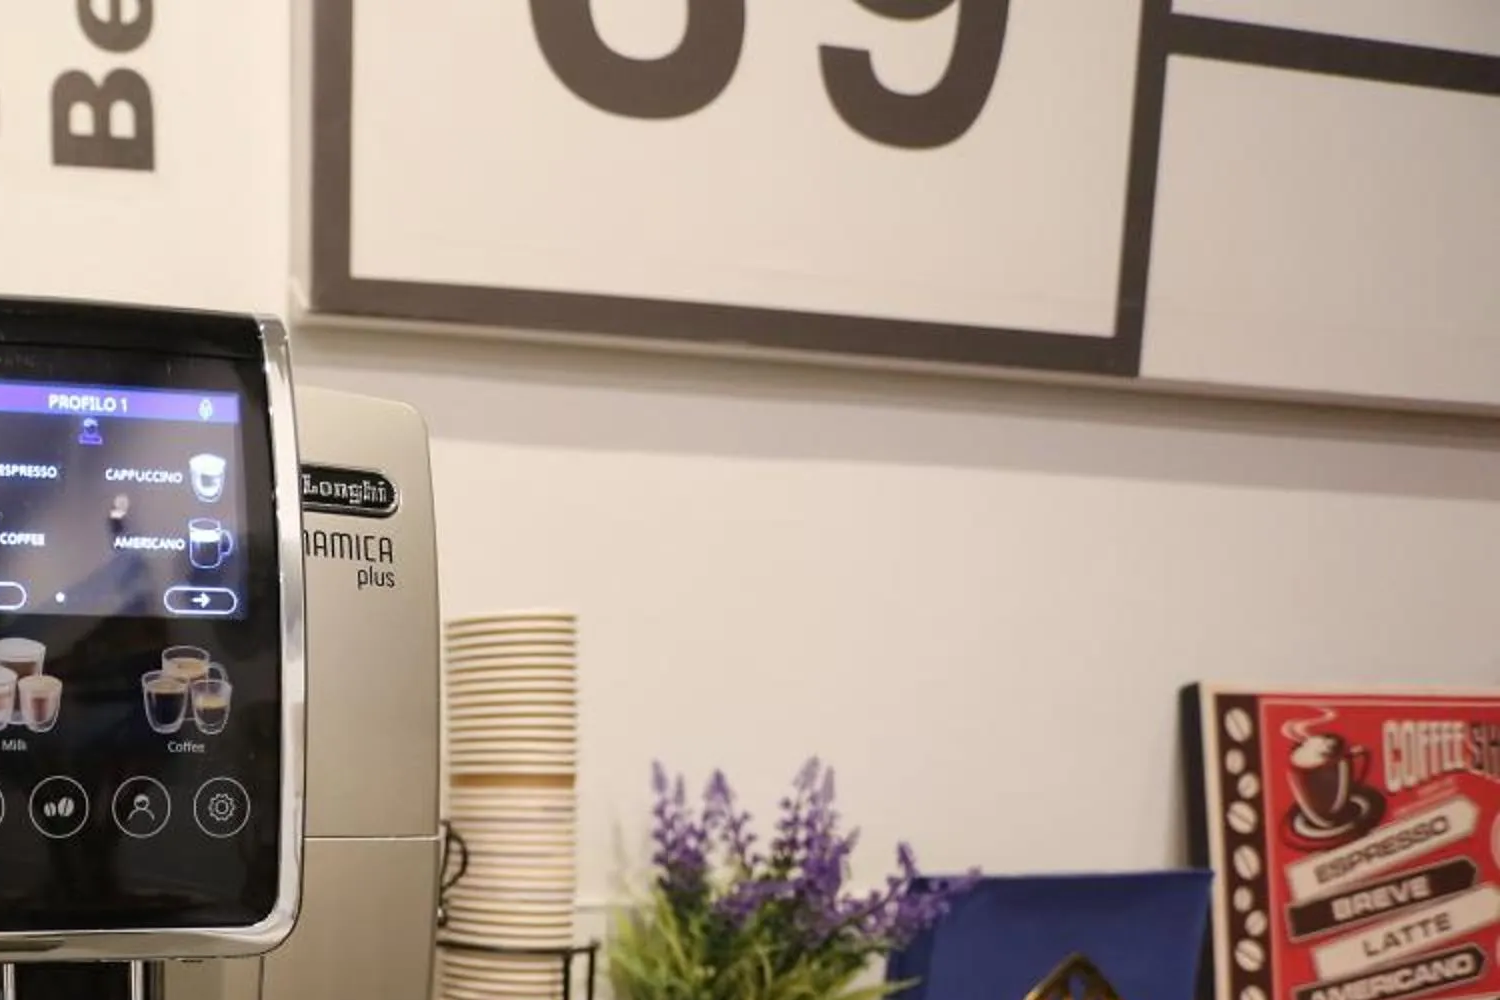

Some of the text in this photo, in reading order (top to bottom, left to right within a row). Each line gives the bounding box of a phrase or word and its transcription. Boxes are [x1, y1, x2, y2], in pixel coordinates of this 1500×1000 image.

[48, 394, 128, 413] PROFILO 1
[105, 468, 183, 485] CAPPUCCINO
[301, 474, 389, 504] Longhi
[0, 533, 46, 547] COFFEE
[113, 536, 186, 551] AMERICANO
[357, 566, 396, 590] plus
[1, 739, 28, 752] Milk
[167, 740, 206, 754] Coffee
[1313, 815, 1450, 884] ESPRESSO
[1331, 874, 1431, 921] BREVE
[1362, 911, 1452, 957] LATTE
